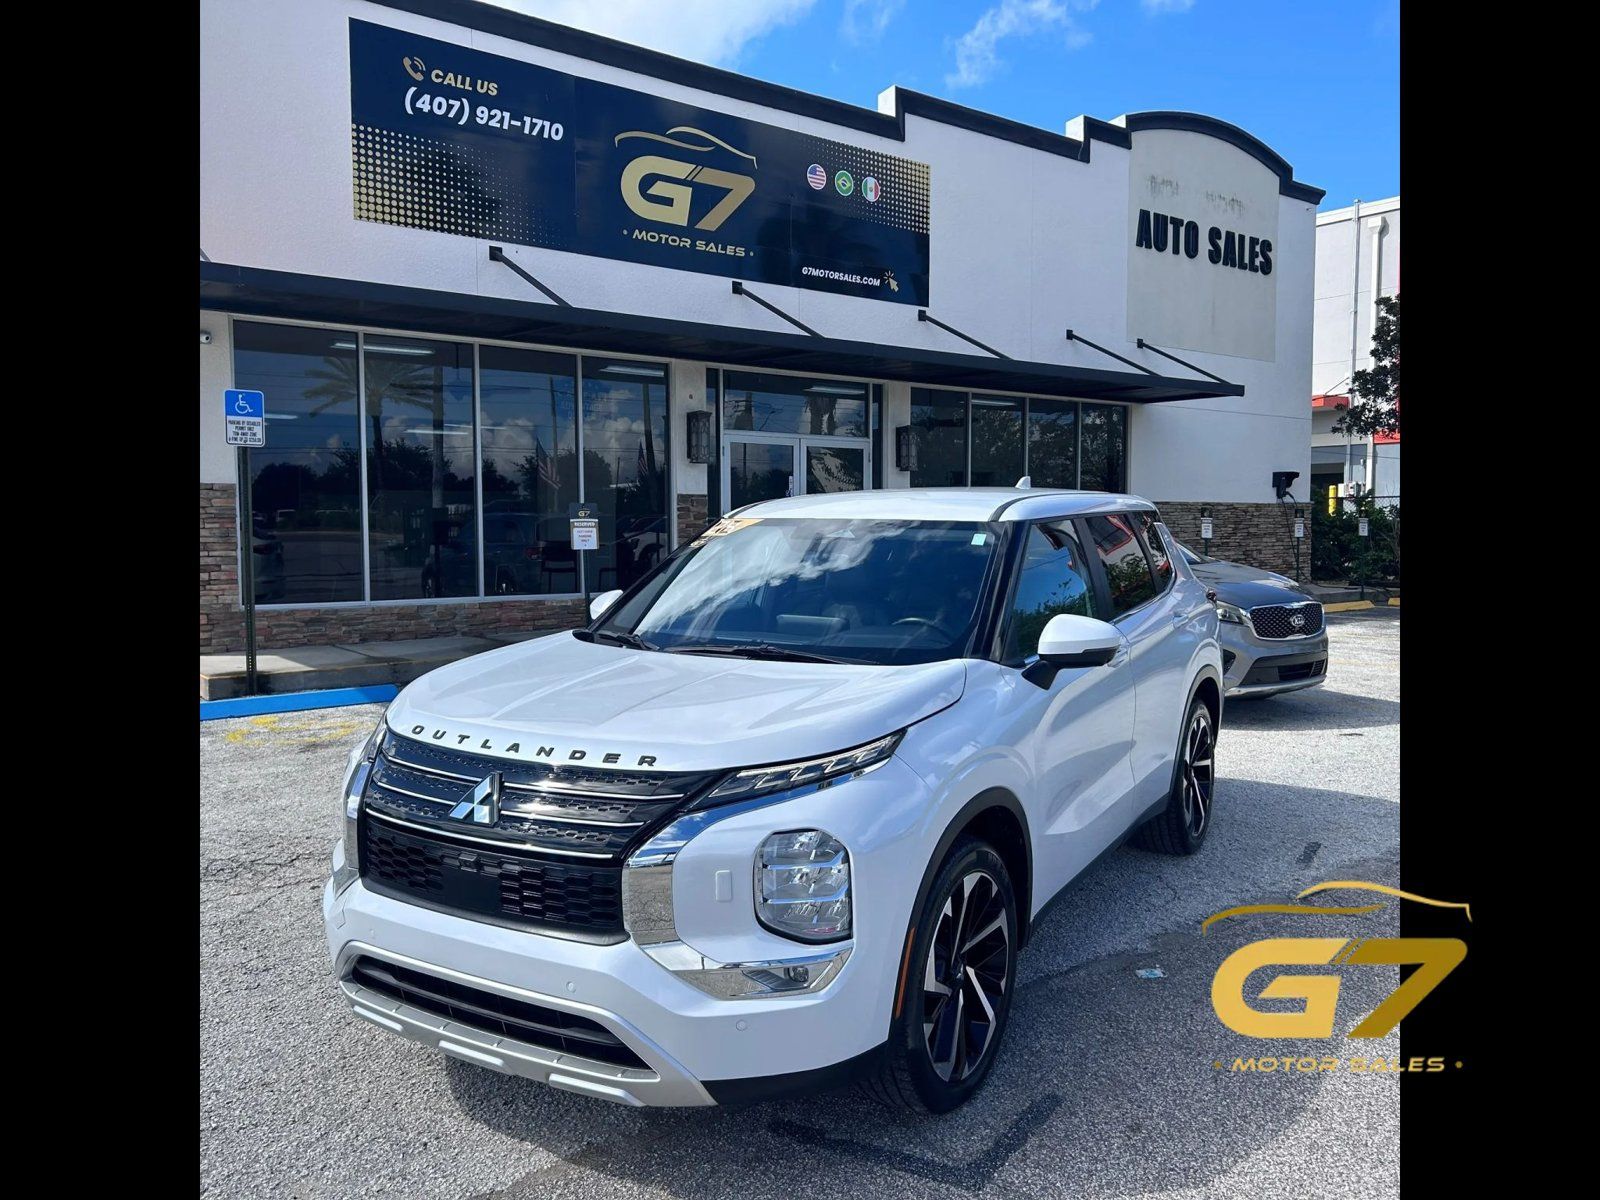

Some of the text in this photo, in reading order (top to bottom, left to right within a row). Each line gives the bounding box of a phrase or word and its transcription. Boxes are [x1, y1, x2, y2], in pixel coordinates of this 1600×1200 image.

[431, 69, 499, 95] CALL US
[404, 86, 564, 141] (407) 921-1710
[620, 155, 756, 232] G7
[632, 228, 745, 257] MOTOR SALES
[1136, 208, 1273, 276] AUTO SALES
[802, 266, 881, 287] G7MOTORSALES.COM
[411, 724, 657, 767] OUTLANDER
